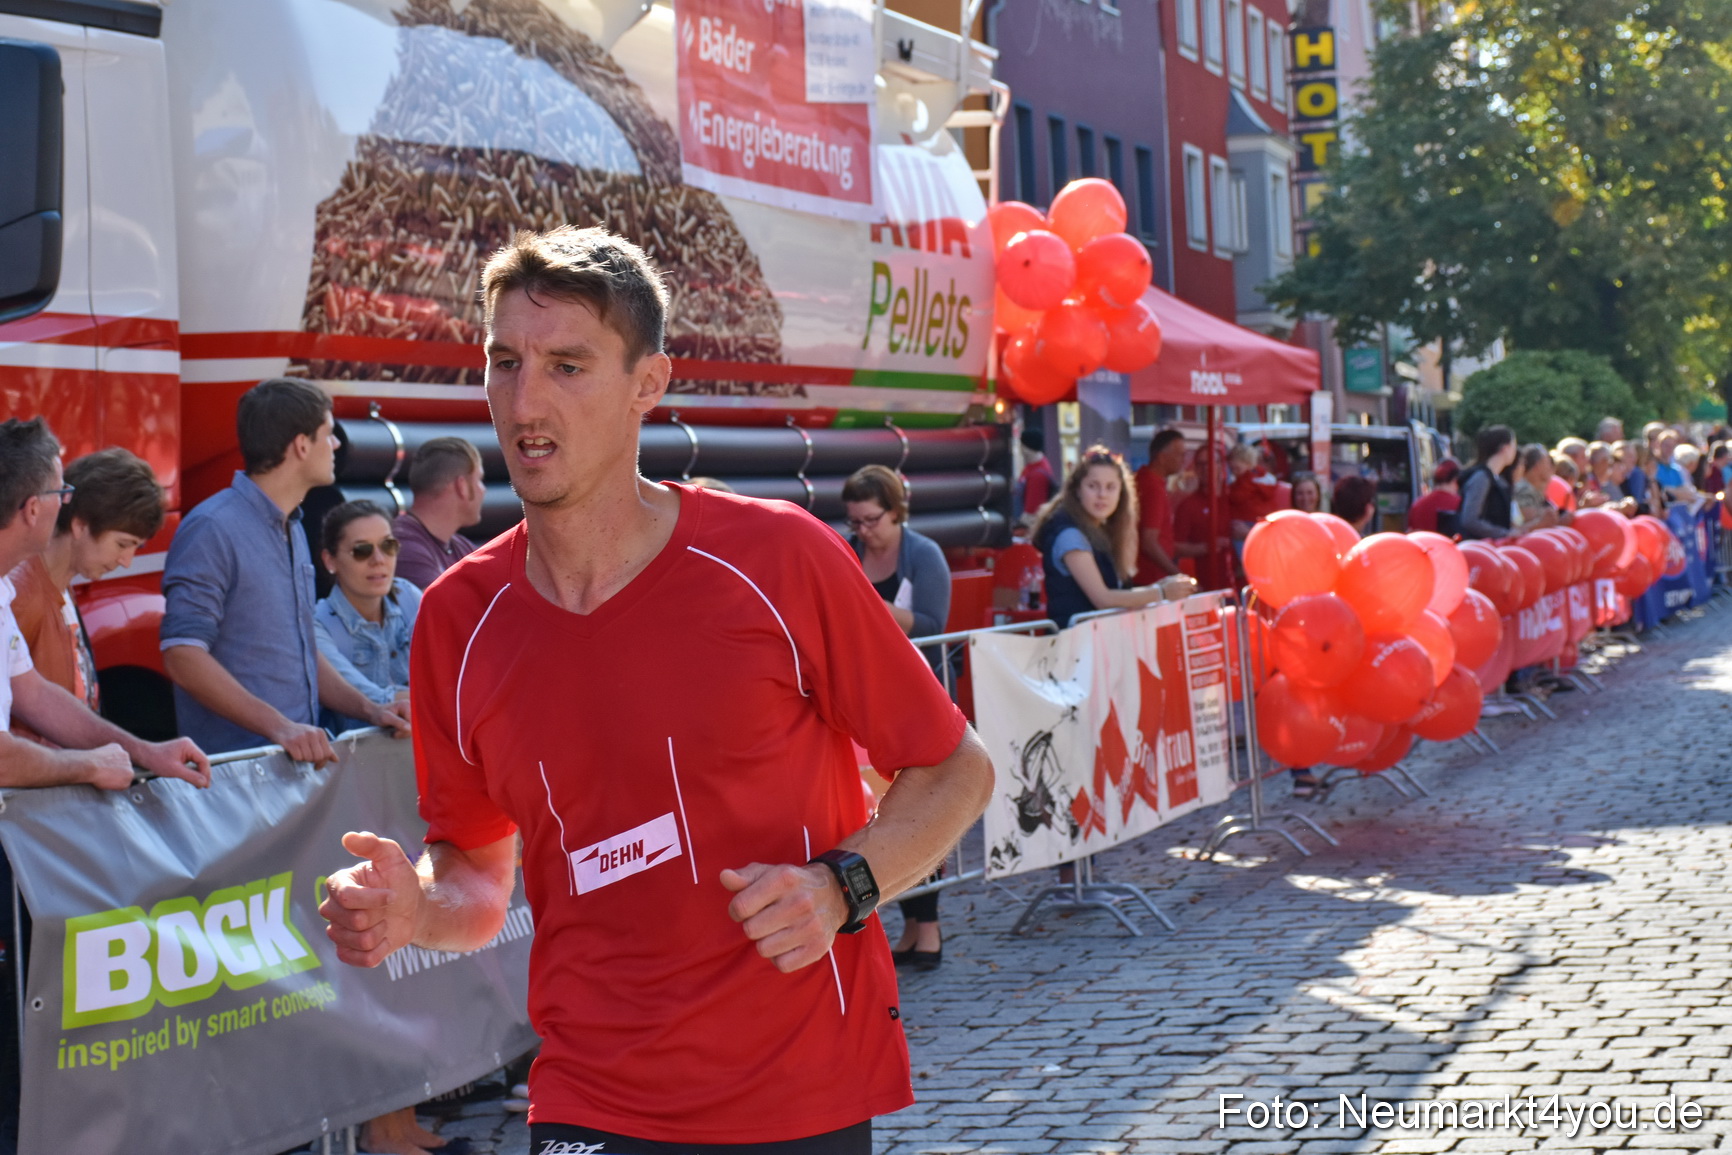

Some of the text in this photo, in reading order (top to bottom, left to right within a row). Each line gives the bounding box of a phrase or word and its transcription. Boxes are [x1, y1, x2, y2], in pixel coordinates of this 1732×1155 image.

[700, 16, 755, 73] Bäder
[862, 261, 971, 359] Pellets
[599, 839, 644, 873] DEHN
[75, 887, 308, 1013] BOCK
[58, 980, 337, 1071] inspired by smart concepts
